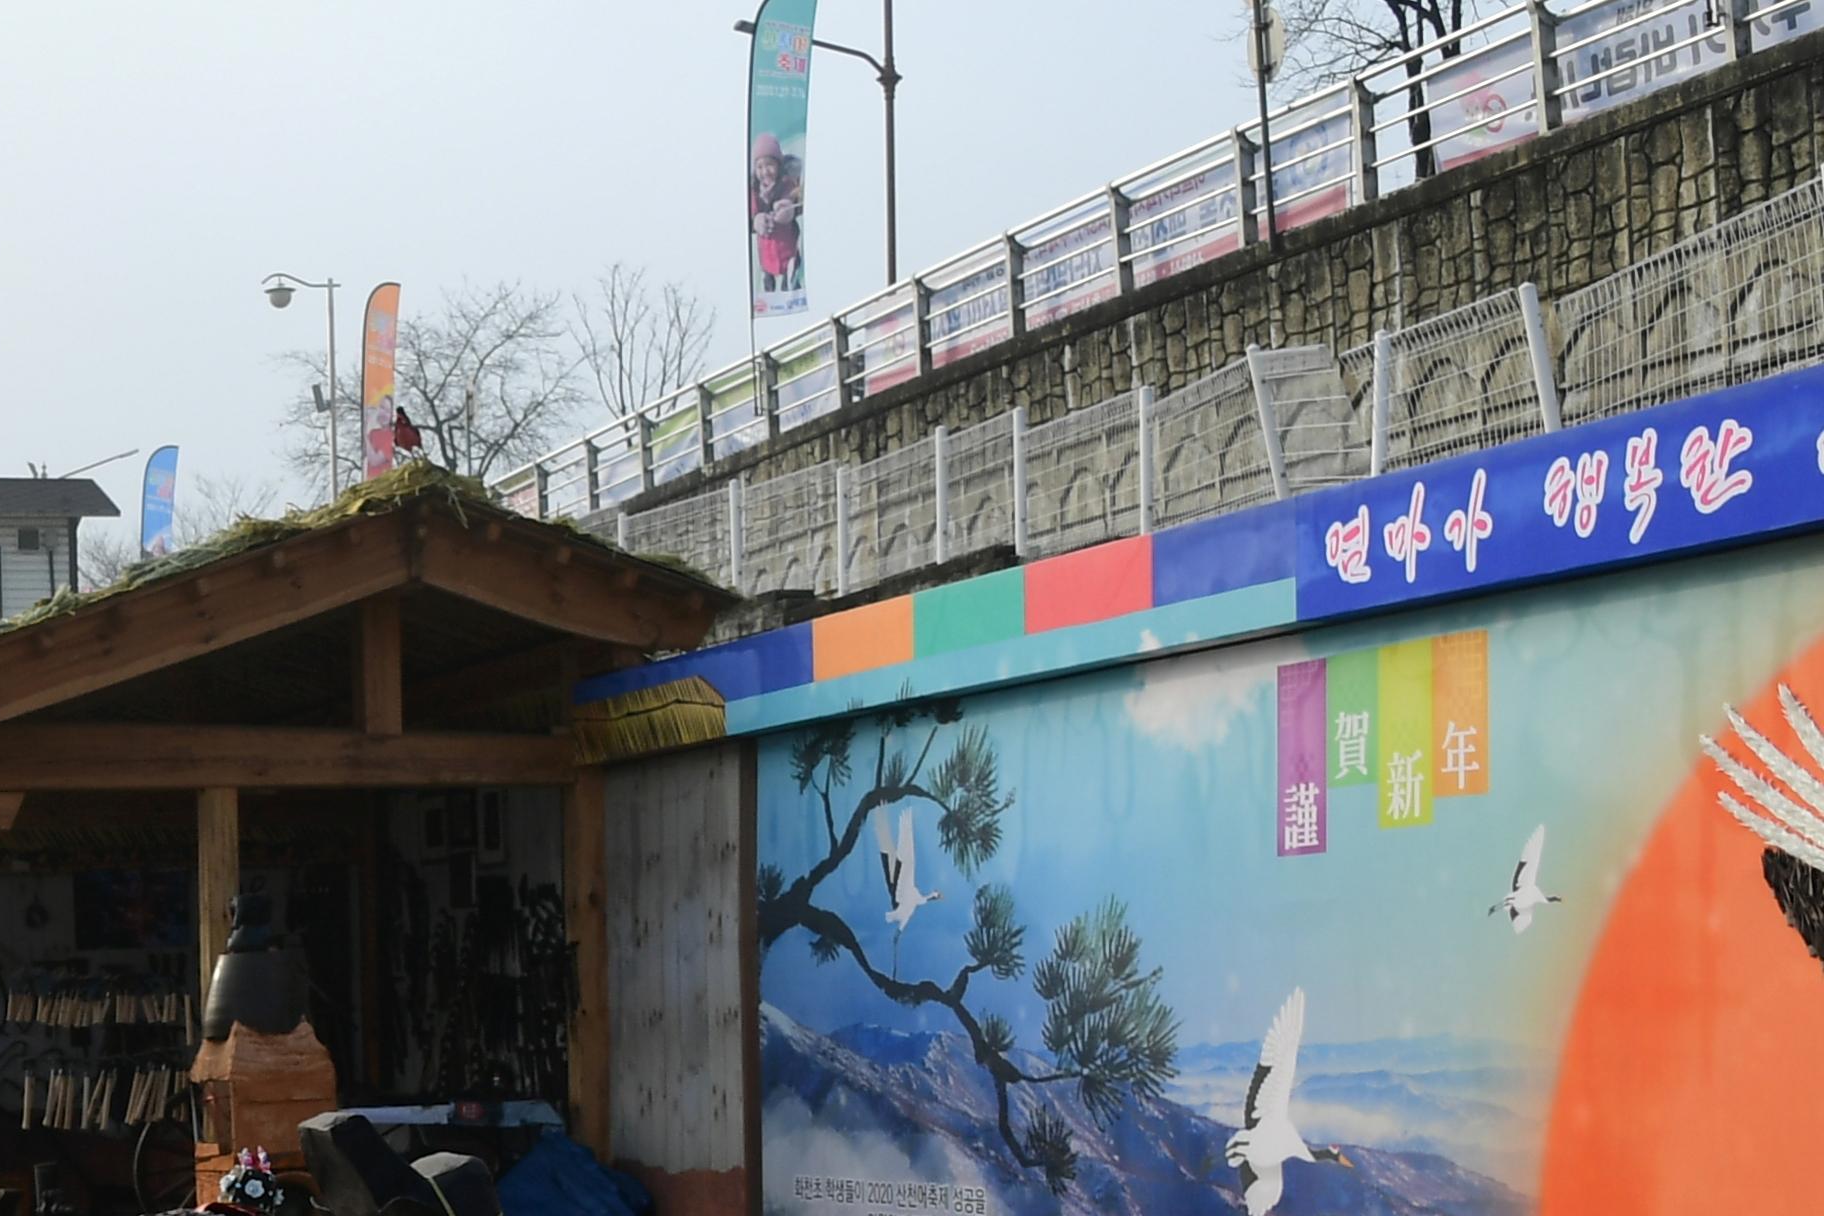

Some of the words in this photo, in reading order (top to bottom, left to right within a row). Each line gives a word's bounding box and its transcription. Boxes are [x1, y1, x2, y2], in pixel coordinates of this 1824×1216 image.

[1544, 418, 1753, 544] 행복한
[795, 1176, 823, 1200] 화천초
[826, 1177, 865, 1204] 학생들이
[868, 1182, 894, 1205] 2020
[896, 1183, 949, 1210] 산천어축제
[953, 1187, 986, 1215] 성공을
